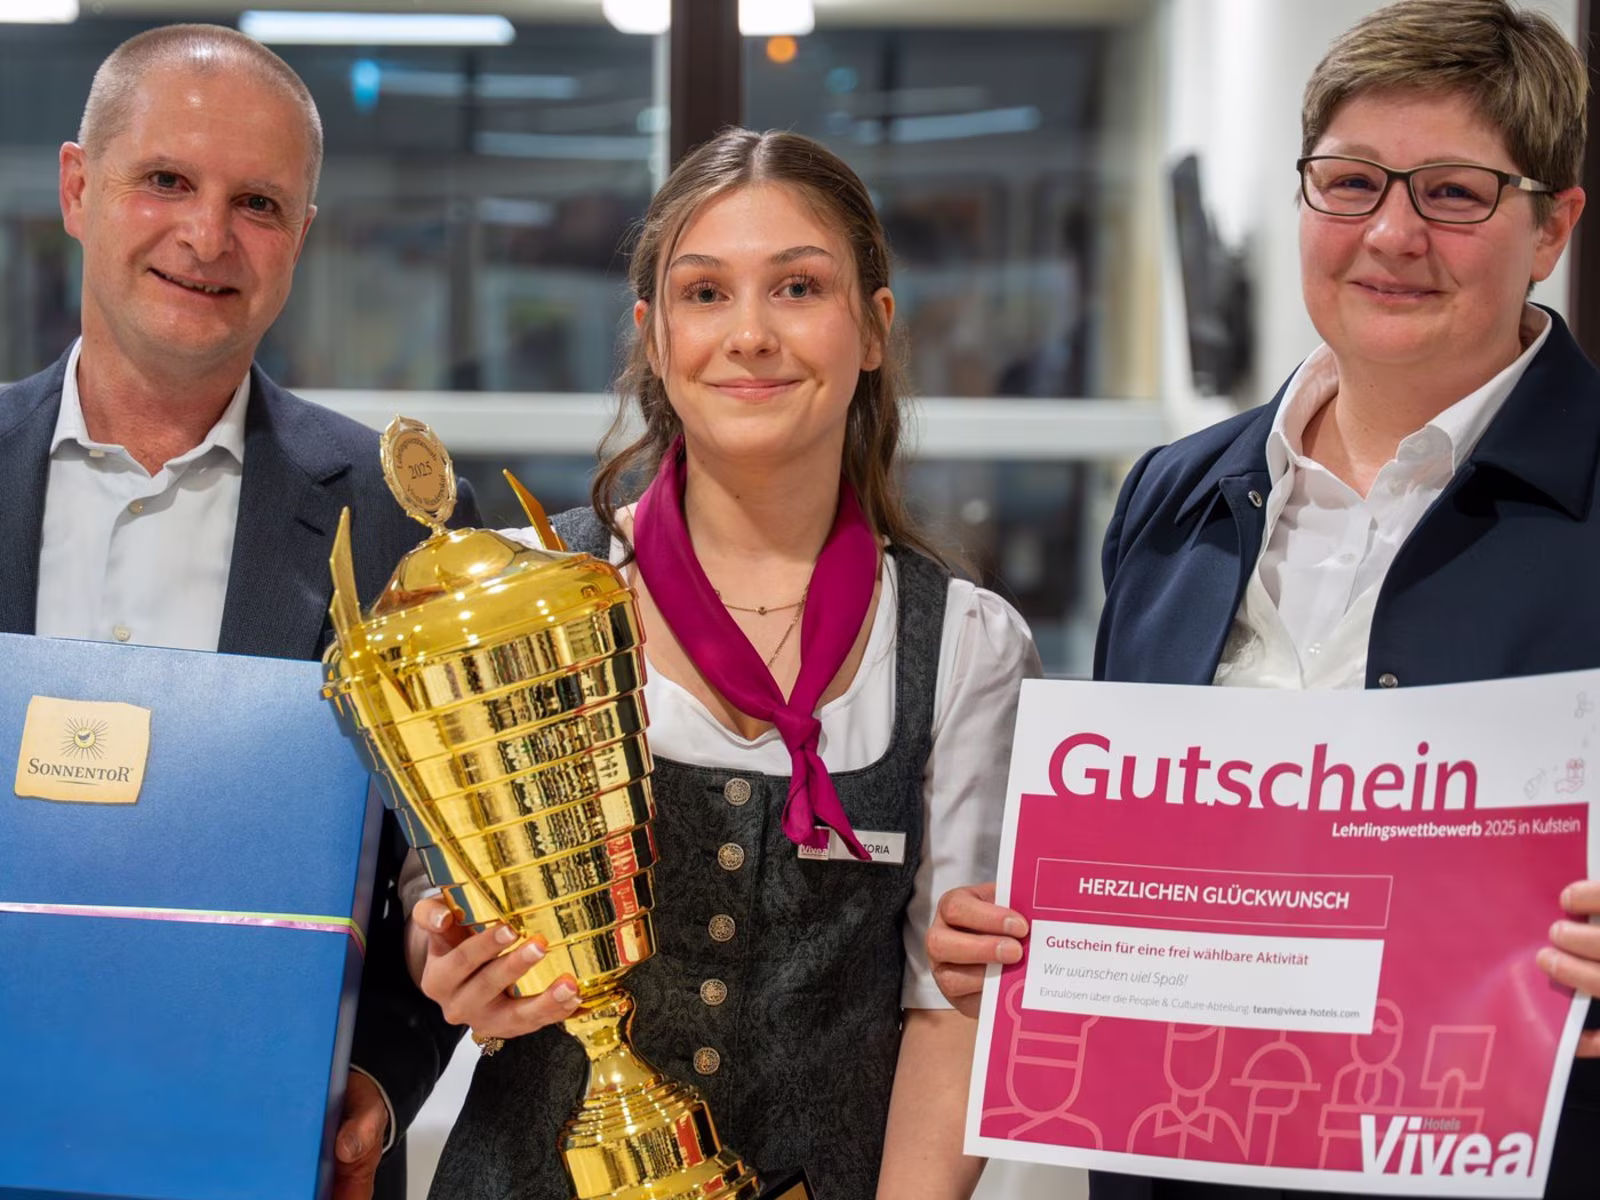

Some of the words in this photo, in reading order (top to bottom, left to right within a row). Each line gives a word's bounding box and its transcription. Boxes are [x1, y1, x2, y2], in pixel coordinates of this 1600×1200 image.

[408, 461, 433, 480] 2025
[27, 758, 130, 783] SONNENTOR
[1048, 732, 1478, 811] Gutschein
[1332, 821, 1482, 841] Lehrlingswettbewerb
[1484, 820, 1516, 836] 2025
[1518, 819, 1530, 834] in
[1532, 816, 1581, 834] Kufstein
[1078, 877, 1199, 903] HERZLICHEN
[1202, 884, 1350, 910] GLÜCKWUNSCH
[1046, 935, 1112, 953] Gutschein
[1115, 941, 1135, 955] für
[1138, 944, 1165, 957] eine
[1168, 945, 1191, 959] frei
[1193, 948, 1253, 963] wählbare
[1256, 951, 1309, 966] Aktivität
[1043, 962, 1065, 976] Wir
[1066, 964, 1128, 983] wünschen
[1131, 970, 1151, 984] viel
[1153, 971, 1188, 988] Spaß!
[1039, 986, 1088, 1001] Einzulösen
[1089, 991, 1111, 1003] über
[1113, 993, 1128, 1005] die
[1129, 994, 1160, 1008] People
[1161, 997, 1169, 1007] &
[1253, 1004, 1360, 1019] team@vivea-hotels.com
[1423, 1117, 1461, 1132] Hotels
[1360, 1114, 1534, 1178] Vivea
